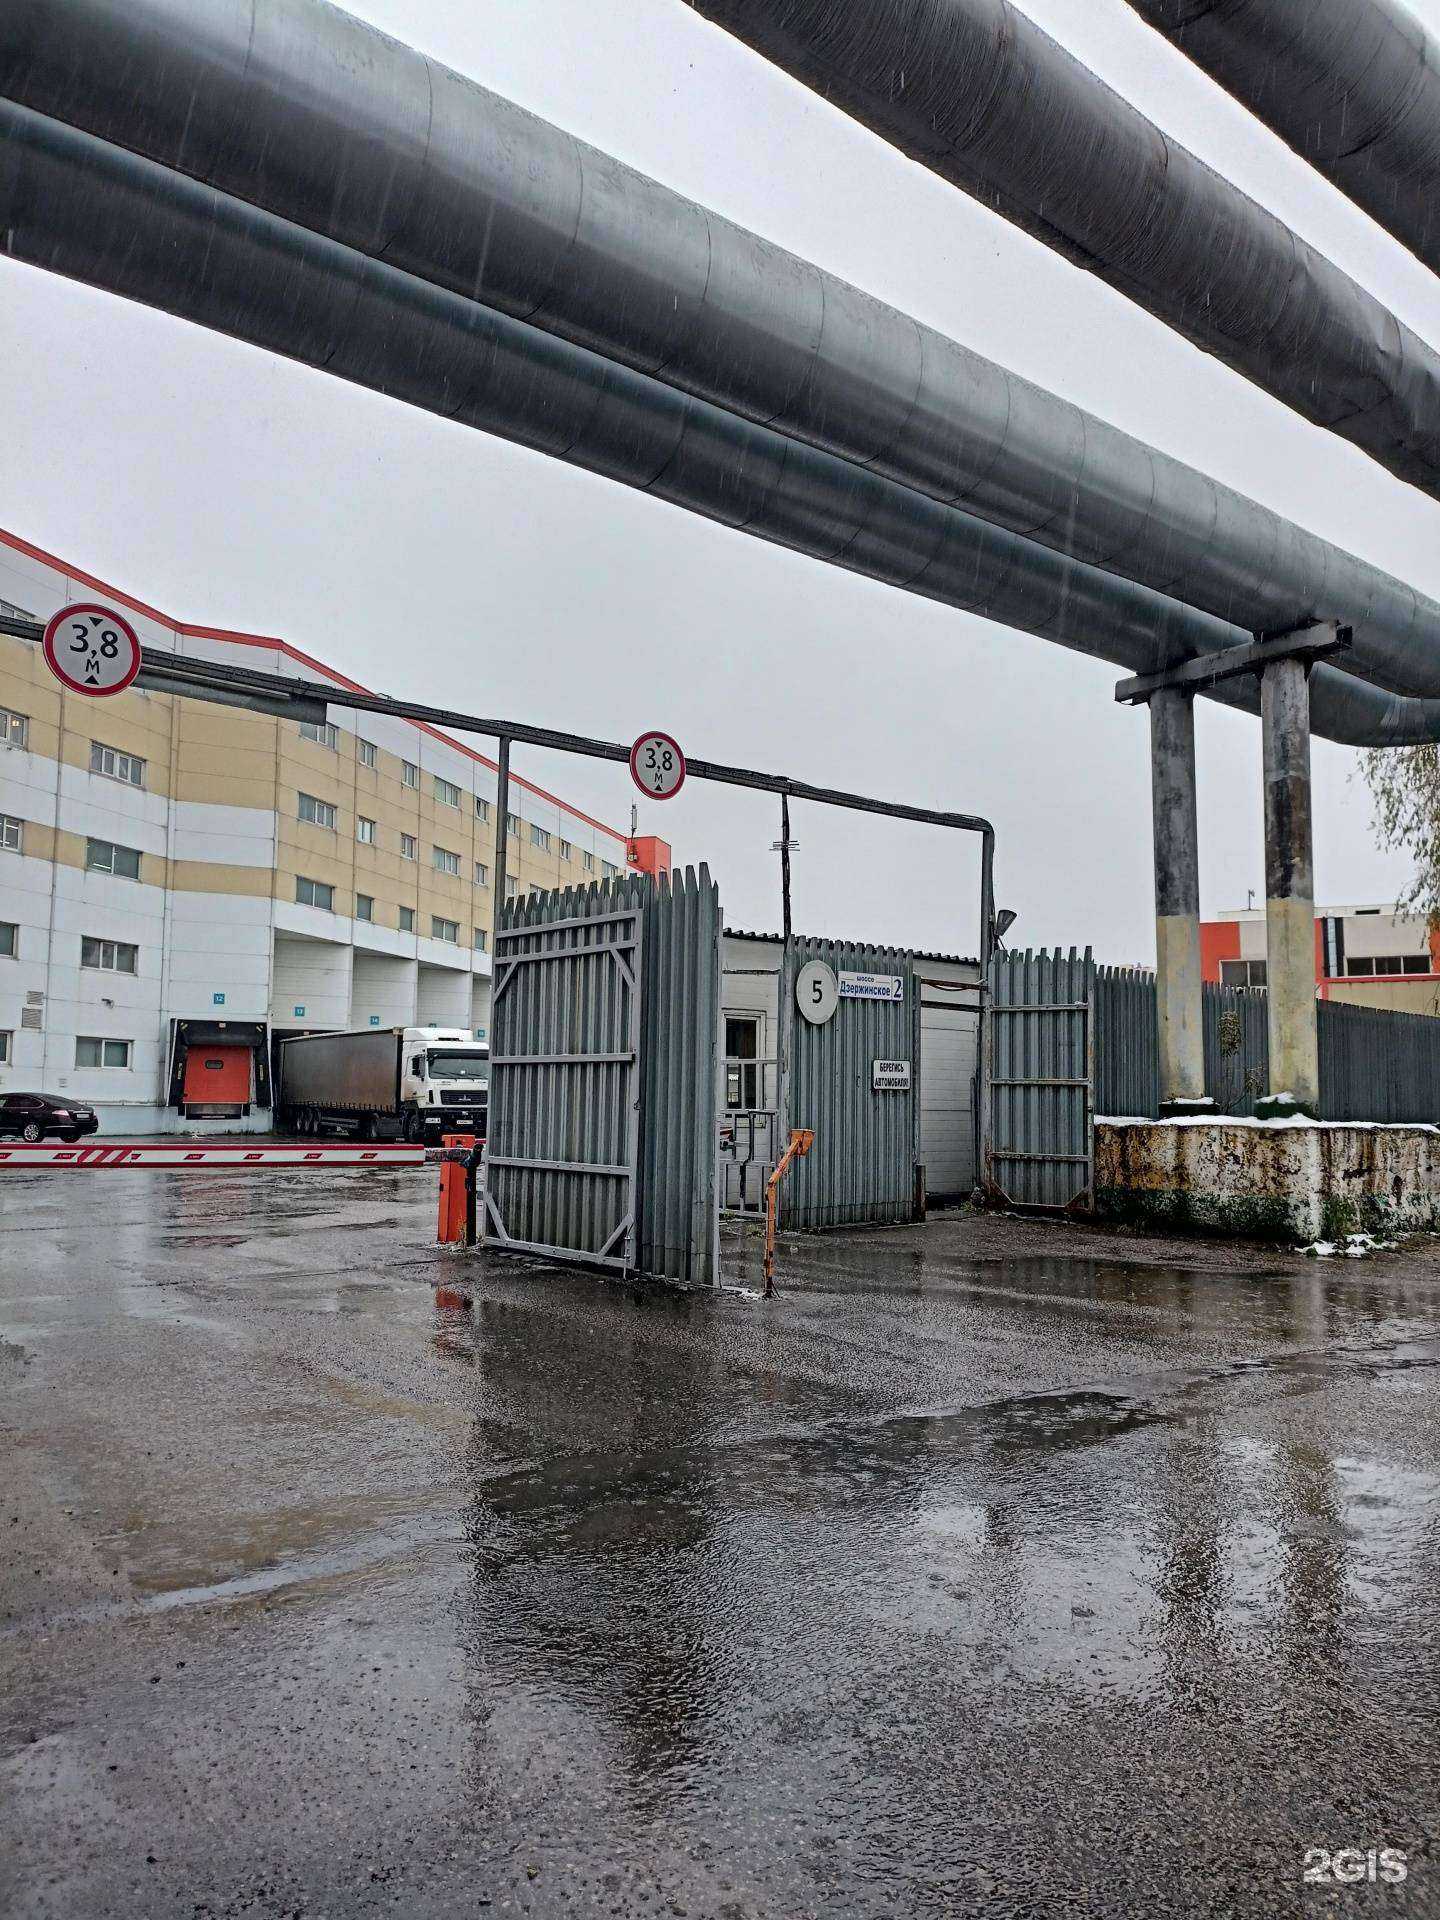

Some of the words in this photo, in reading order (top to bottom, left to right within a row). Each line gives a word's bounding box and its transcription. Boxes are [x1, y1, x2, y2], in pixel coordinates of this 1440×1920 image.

[70, 624, 118, 659] 3,8
[645, 747, 673, 772] 3,8
[812, 980, 823, 1003] 5
[840, 980, 891, 996] Дзержинское
[893, 978, 902, 998] 2
[879, 1062, 904, 1072] БЕРЕГИСЬ
